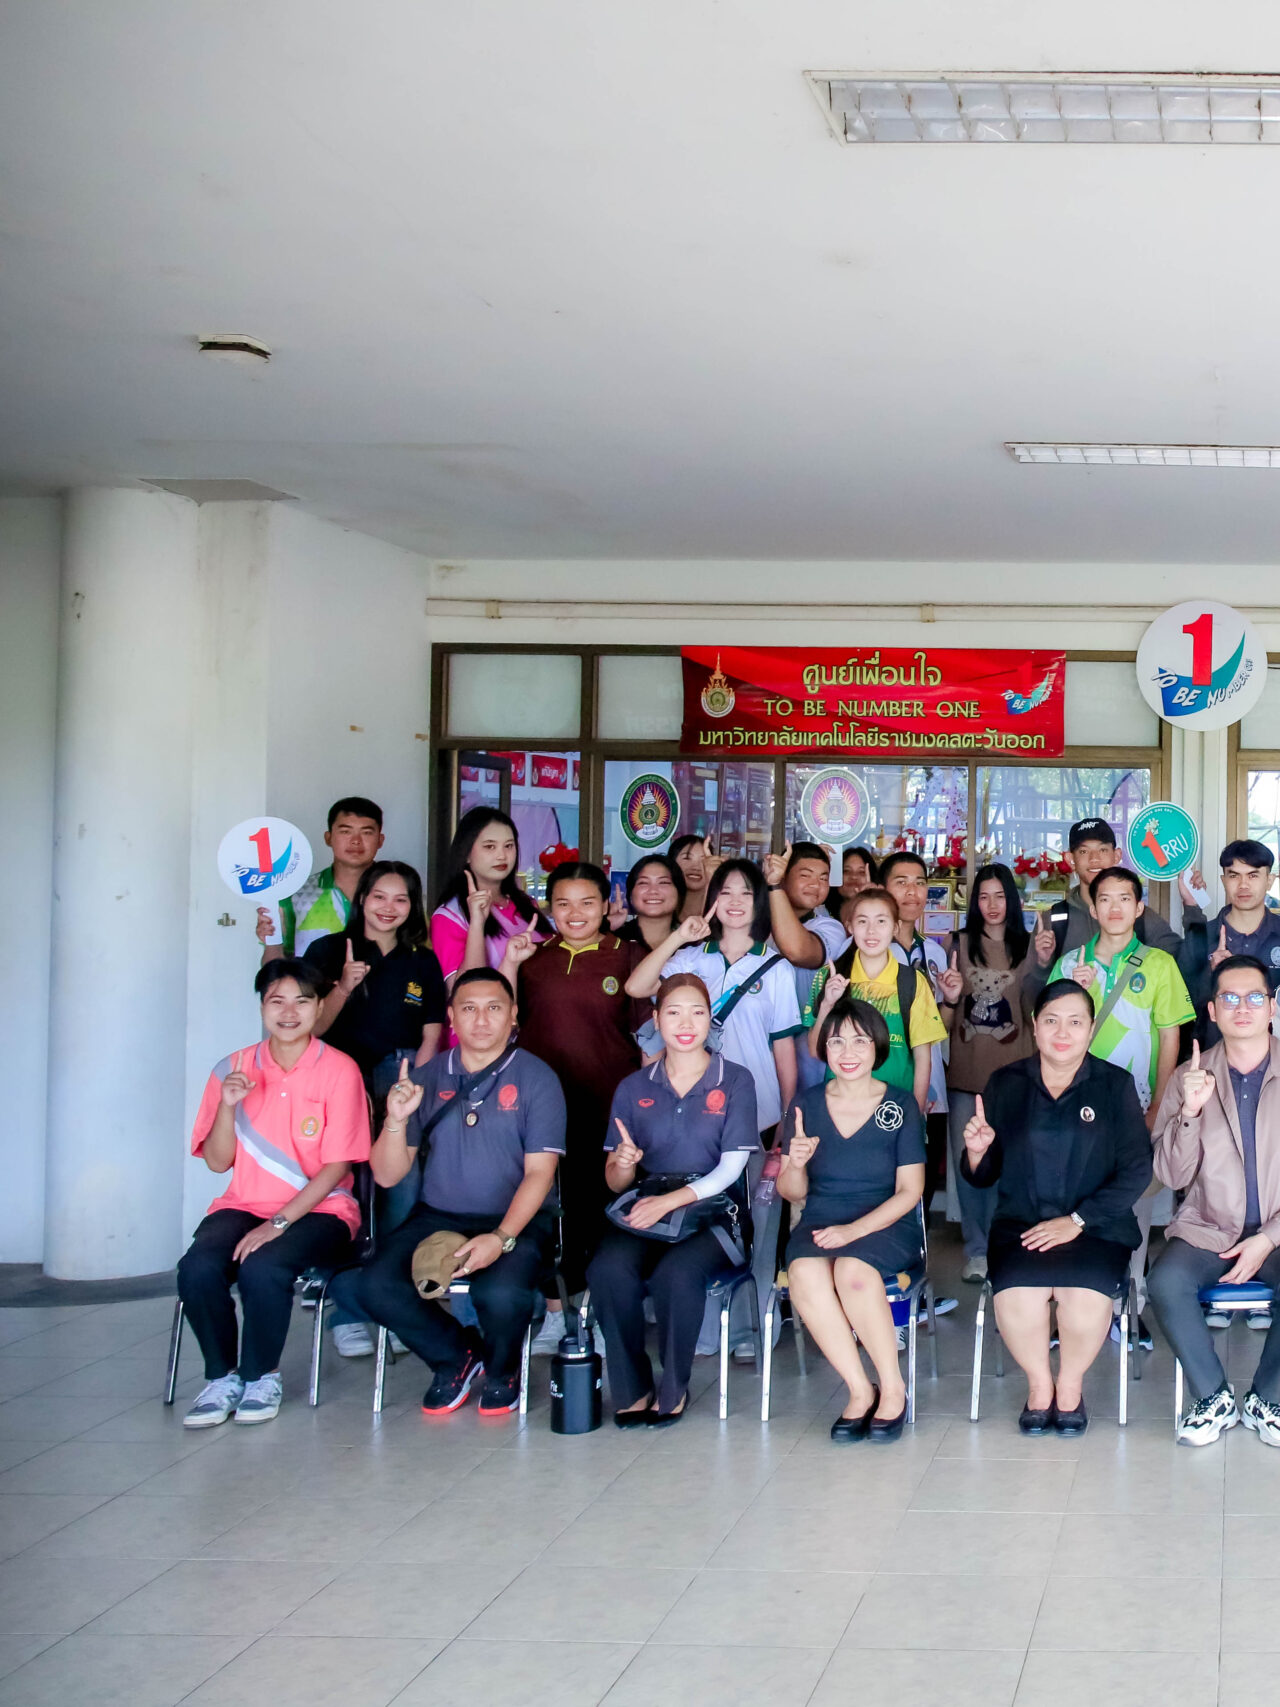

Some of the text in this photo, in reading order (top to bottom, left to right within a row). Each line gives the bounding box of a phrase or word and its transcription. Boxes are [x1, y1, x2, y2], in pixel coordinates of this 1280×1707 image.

[1183, 613, 1213, 686] 1
[801, 650, 943, 694] ศูนย์เพื่อนใจ
[1151, 668, 1178, 688] TO
[1172, 686, 1201, 706] BE
[763, 699, 981, 719] TO BE NUMBER ONE
[1012, 699, 1026, 710] BE
[698, 722, 1045, 750] มหาวิทยาลัยเทคโนโลยีราชมงคลตะวันออก
[248, 827, 273, 873] 1
[247, 874, 267, 887] BE
